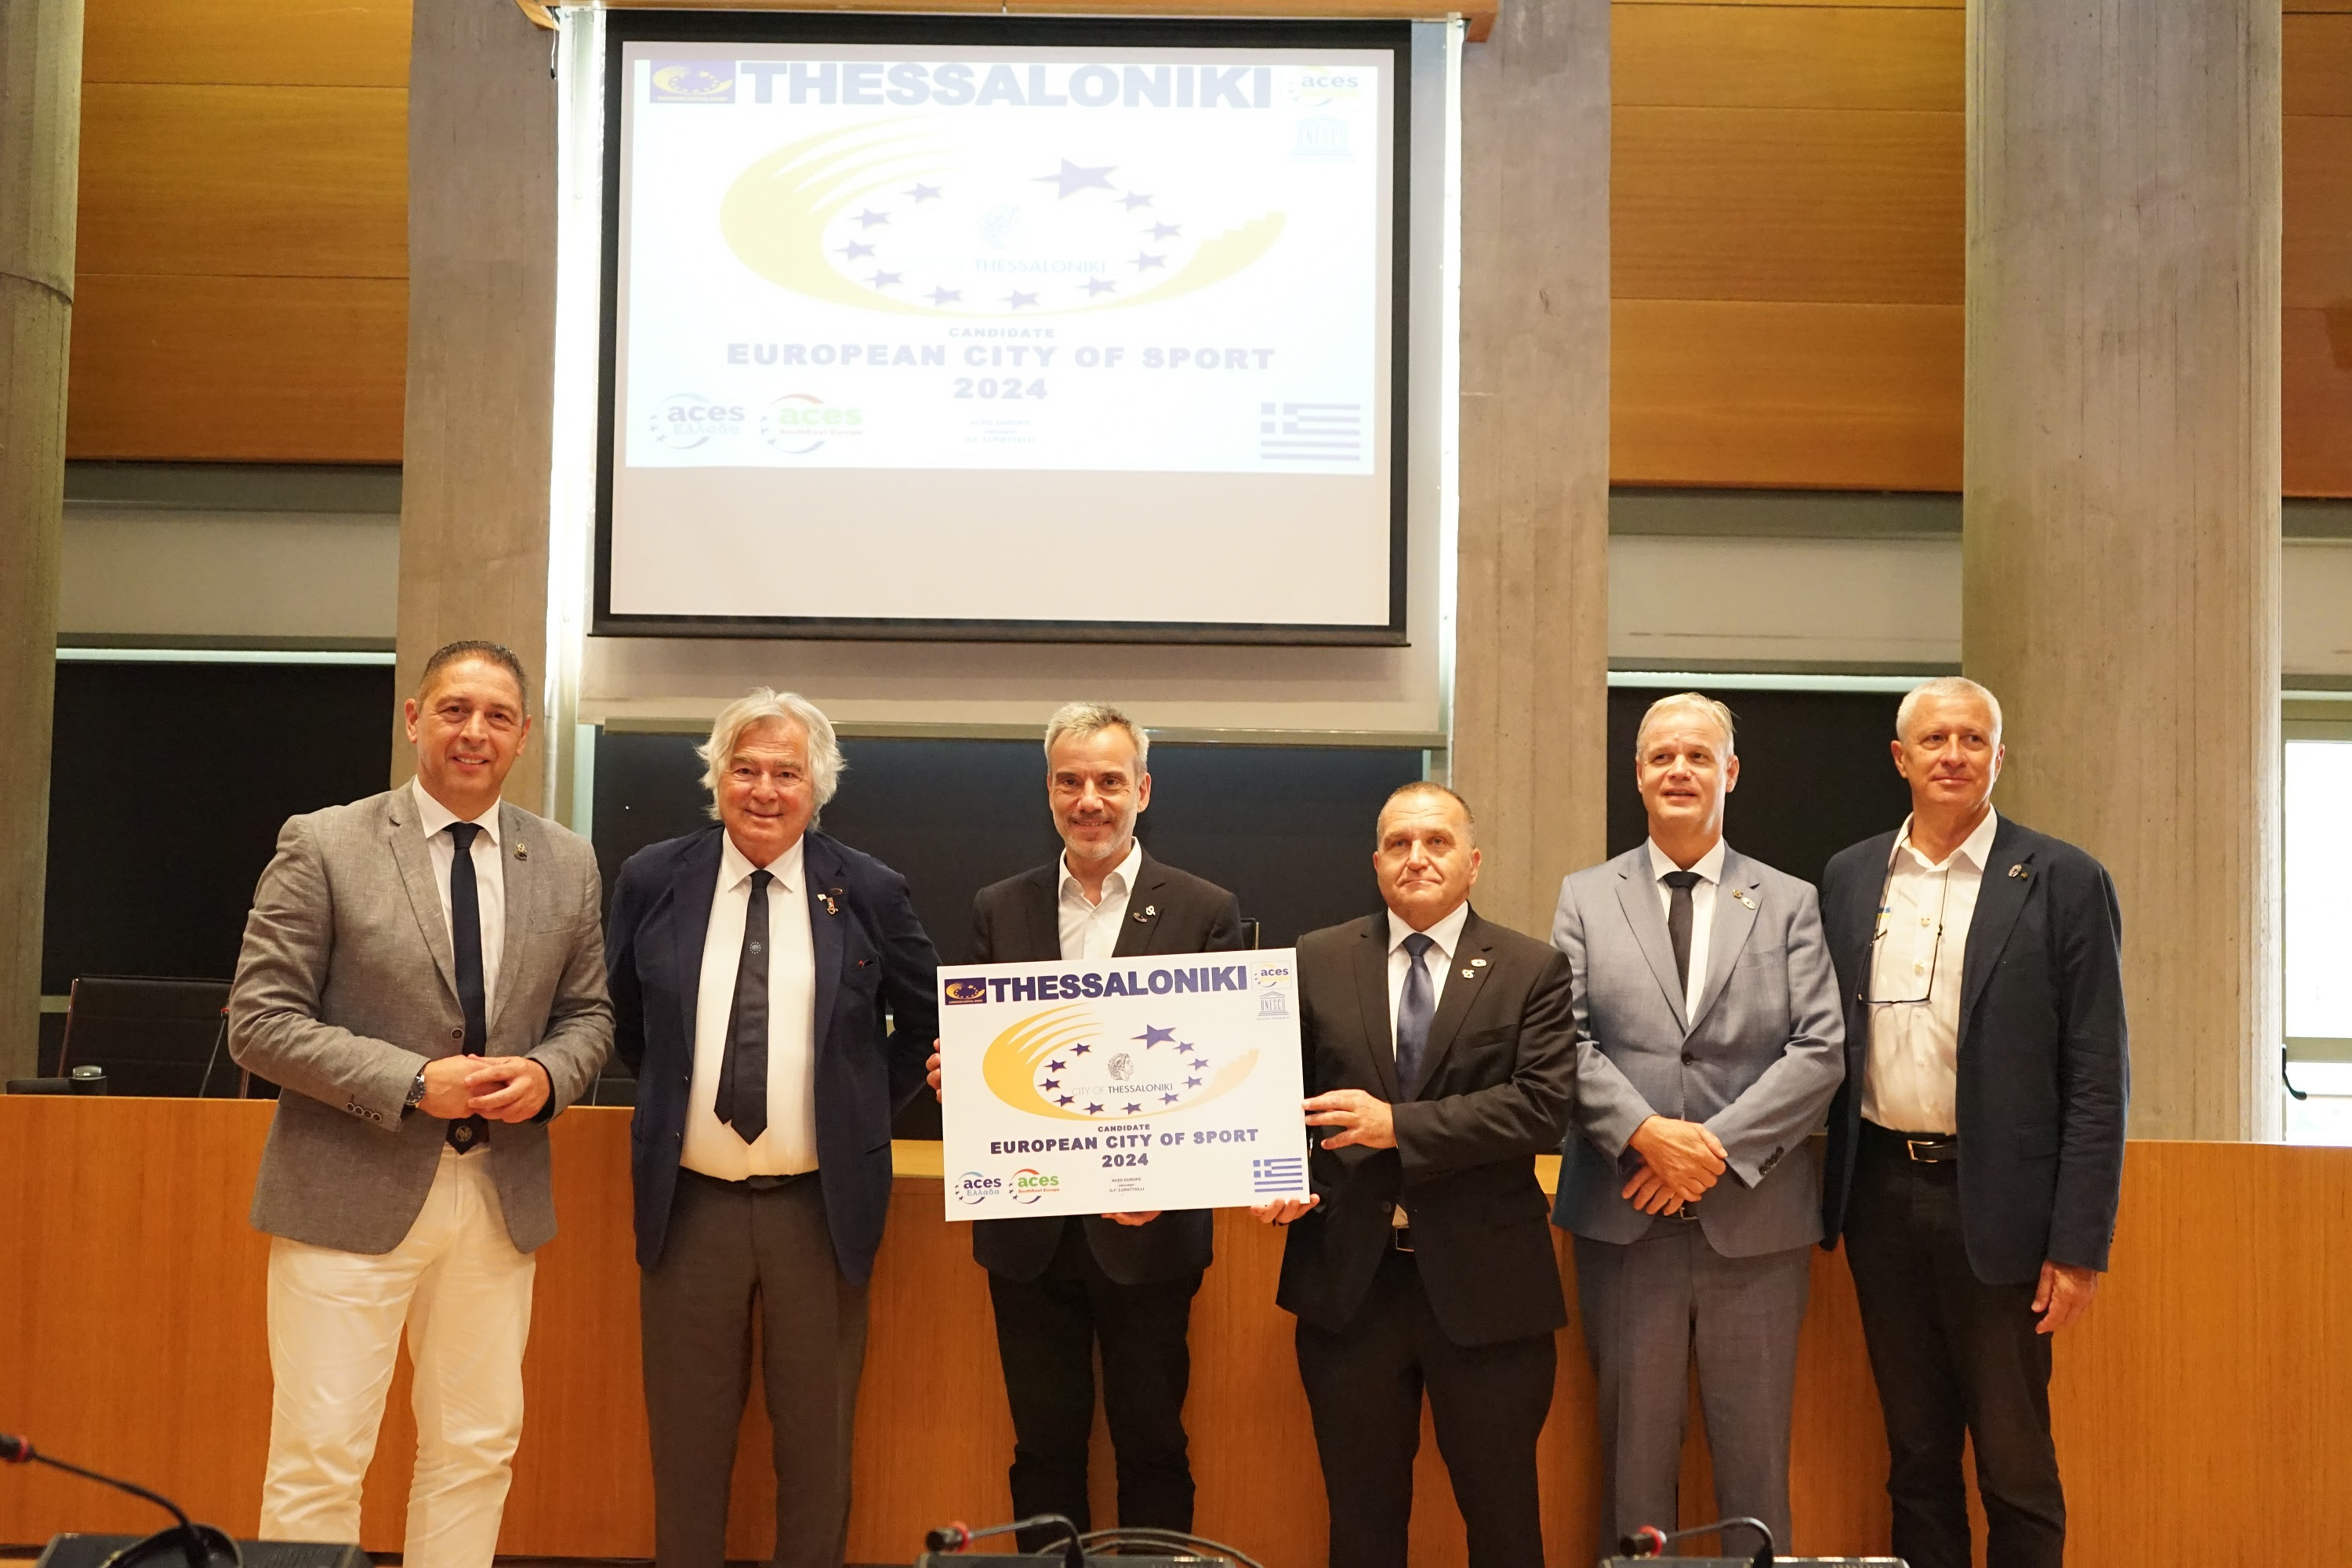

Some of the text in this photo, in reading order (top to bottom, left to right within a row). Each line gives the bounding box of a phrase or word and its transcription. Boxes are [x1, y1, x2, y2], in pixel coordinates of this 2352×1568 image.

[740, 62, 1272, 108] THESSALONIKI
[1301, 75, 1359, 88] aces
[975, 259, 1106, 274] THESSALONIKI
[949, 328, 1055, 339] CANDIDATE
[727, 343, 1276, 370] EUROPEAN CITY OF SPORT
[953, 377, 1047, 400] 2024
[667, 405, 746, 423] aces
[779, 407, 864, 426] aces
[988, 965, 1247, 1003] THESSALONIKI
[1072, 1083, 1173, 1095] CITY OF THESSALONIKI
[991, 1128, 1258, 1154] EUROPEAN CITY OF SPORT
[1102, 1152, 1149, 1167] 2024
[964, 1178, 1002, 1189] aces
[1018, 1176, 1059, 1187] aces
